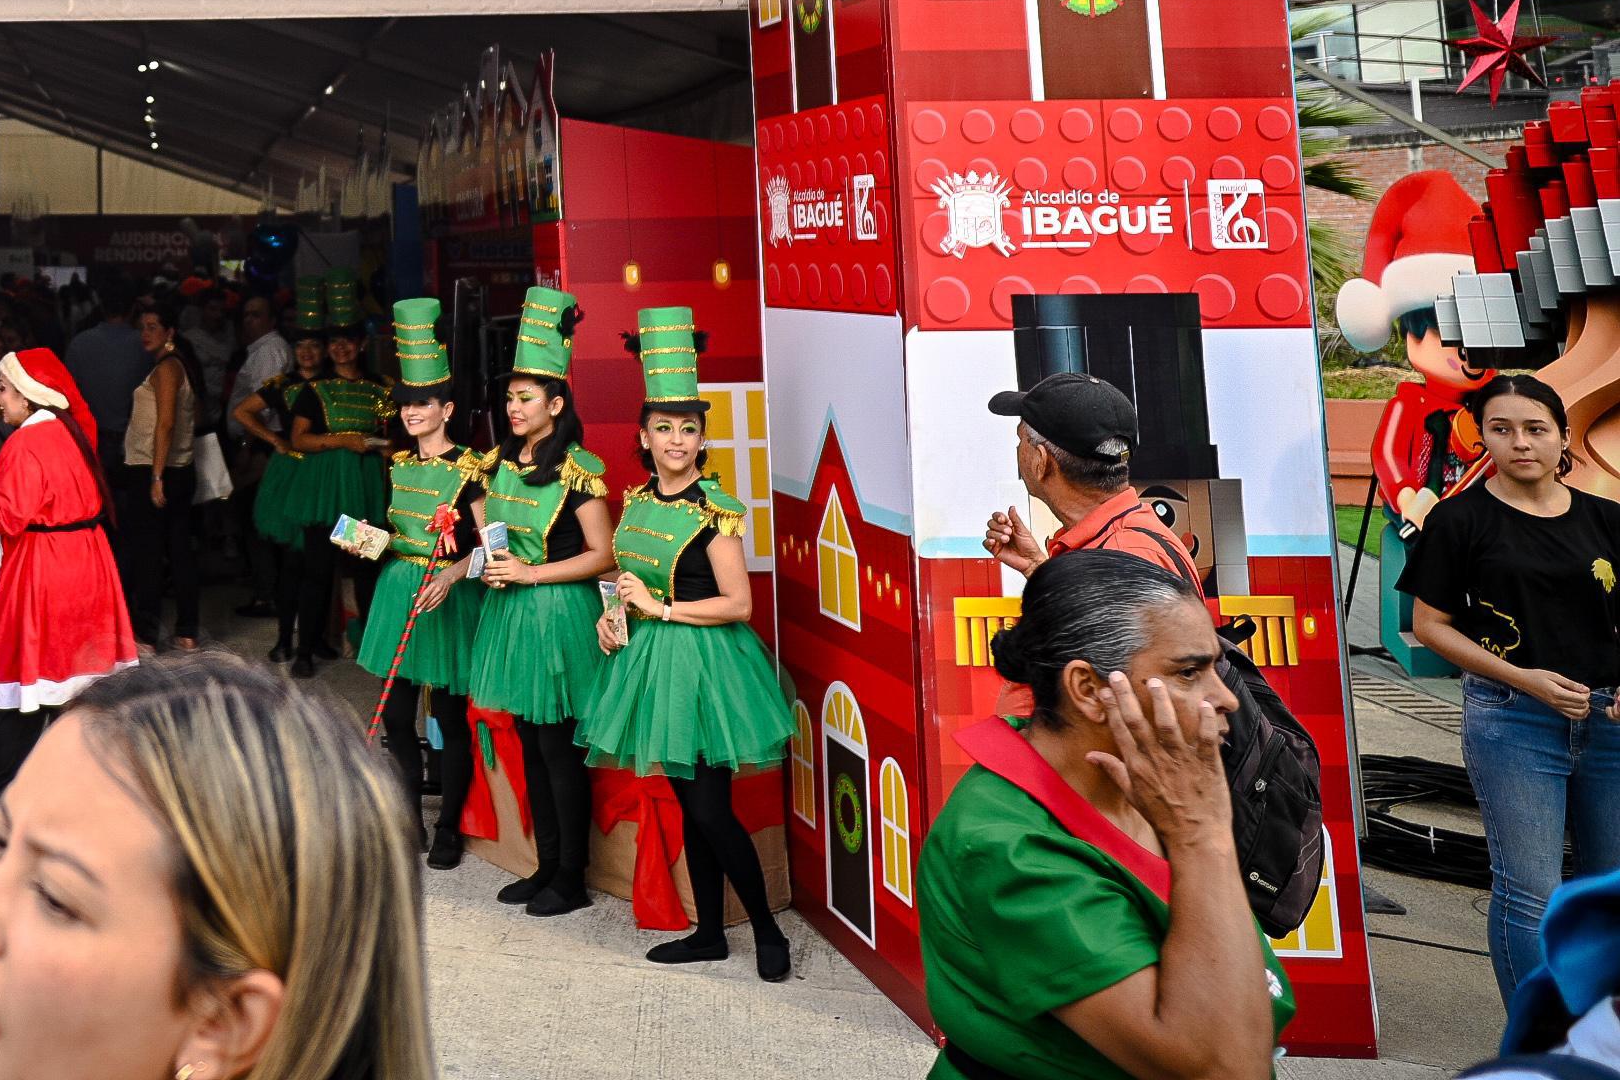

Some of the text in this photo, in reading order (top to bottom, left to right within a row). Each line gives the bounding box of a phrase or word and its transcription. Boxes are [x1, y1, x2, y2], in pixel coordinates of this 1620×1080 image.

[793, 193, 844, 228] IBAGUÉ
[1022, 189, 1121, 205] Alcaldía de
[1021, 197, 1174, 235] IBAGUÉ
